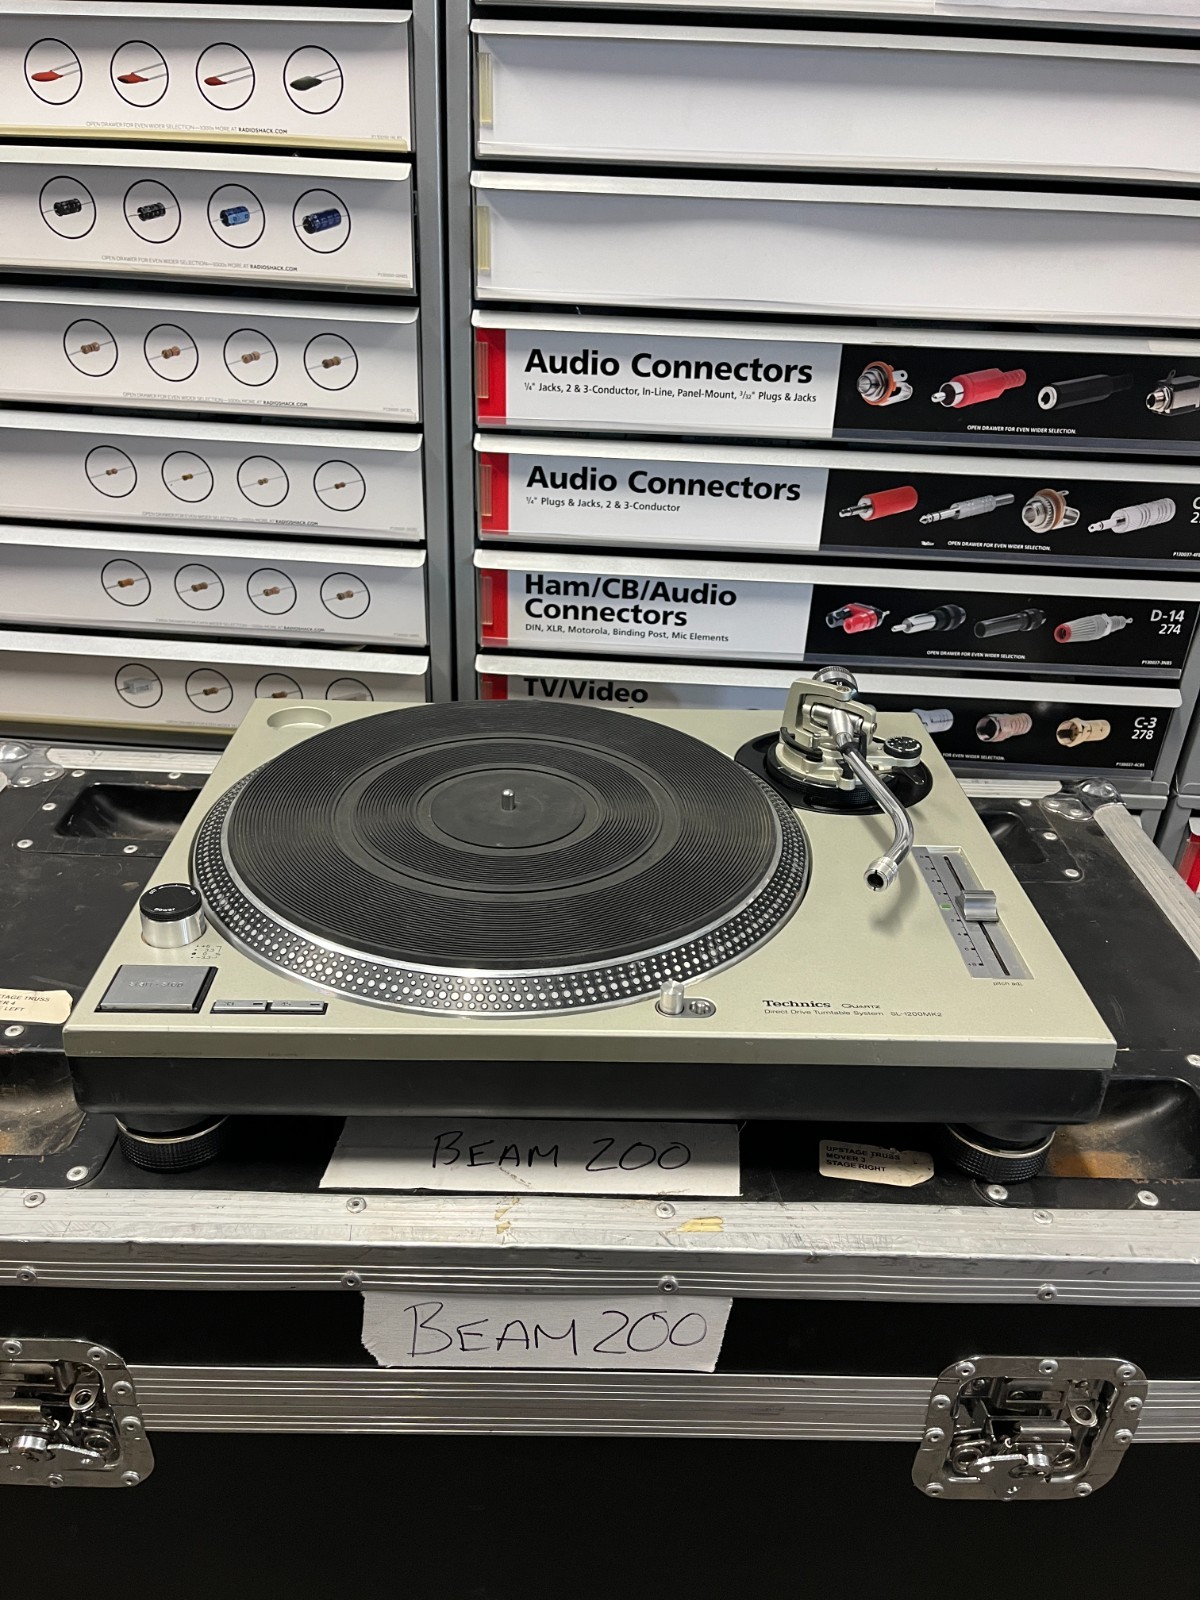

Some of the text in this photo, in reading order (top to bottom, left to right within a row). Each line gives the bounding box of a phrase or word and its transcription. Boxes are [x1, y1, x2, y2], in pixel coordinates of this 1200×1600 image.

[524, 349, 812, 384] Audio Connectors
[539, 383, 564, 393] Jacks,
[566, 384, 572, 392] 2
[574, 384, 581, 392] &
[583, 385, 640, 396] 3-Conductor,
[642, 387, 675, 398] In-Line,
[678, 388, 737, 400] Panel-Mount,
[758, 392, 782, 402] Plugs
[784, 393, 792, 401] &
[794, 393, 817, 402] Jacks
[526, 466, 800, 501] Audio Connectors
[541, 497, 565, 508] Plugs
[577, 499, 603, 509] Jacks,
[606, 501, 612, 509] 2
[615, 501, 621, 509] &
[624, 501, 680, 512] 3-Conductor
[1190, 512, 1200, 523] 2
[526, 574, 737, 606] Ham/CB/Audio
[525, 598, 687, 626] Connectors
[1150, 610, 1184, 622] D-14
[526, 624, 729, 642] DIN, XLR, Motorola, Binding Post, Mic Elements
[1158, 624, 1181, 634] 274
[523, 678, 648, 703] TV/Video
[1134, 716, 1158, 728] C-3
[1131, 729, 1154, 740] 278
[432, 1130, 691, 1171] BEAM 200
[826, 1146, 900, 1160] UPSTAGE TRUSS
[826, 1153, 858, 1162] MOVER
[826, 1160, 886, 1172] STAGE RIGHT
[403, 1301, 707, 1358] BEAM 200
